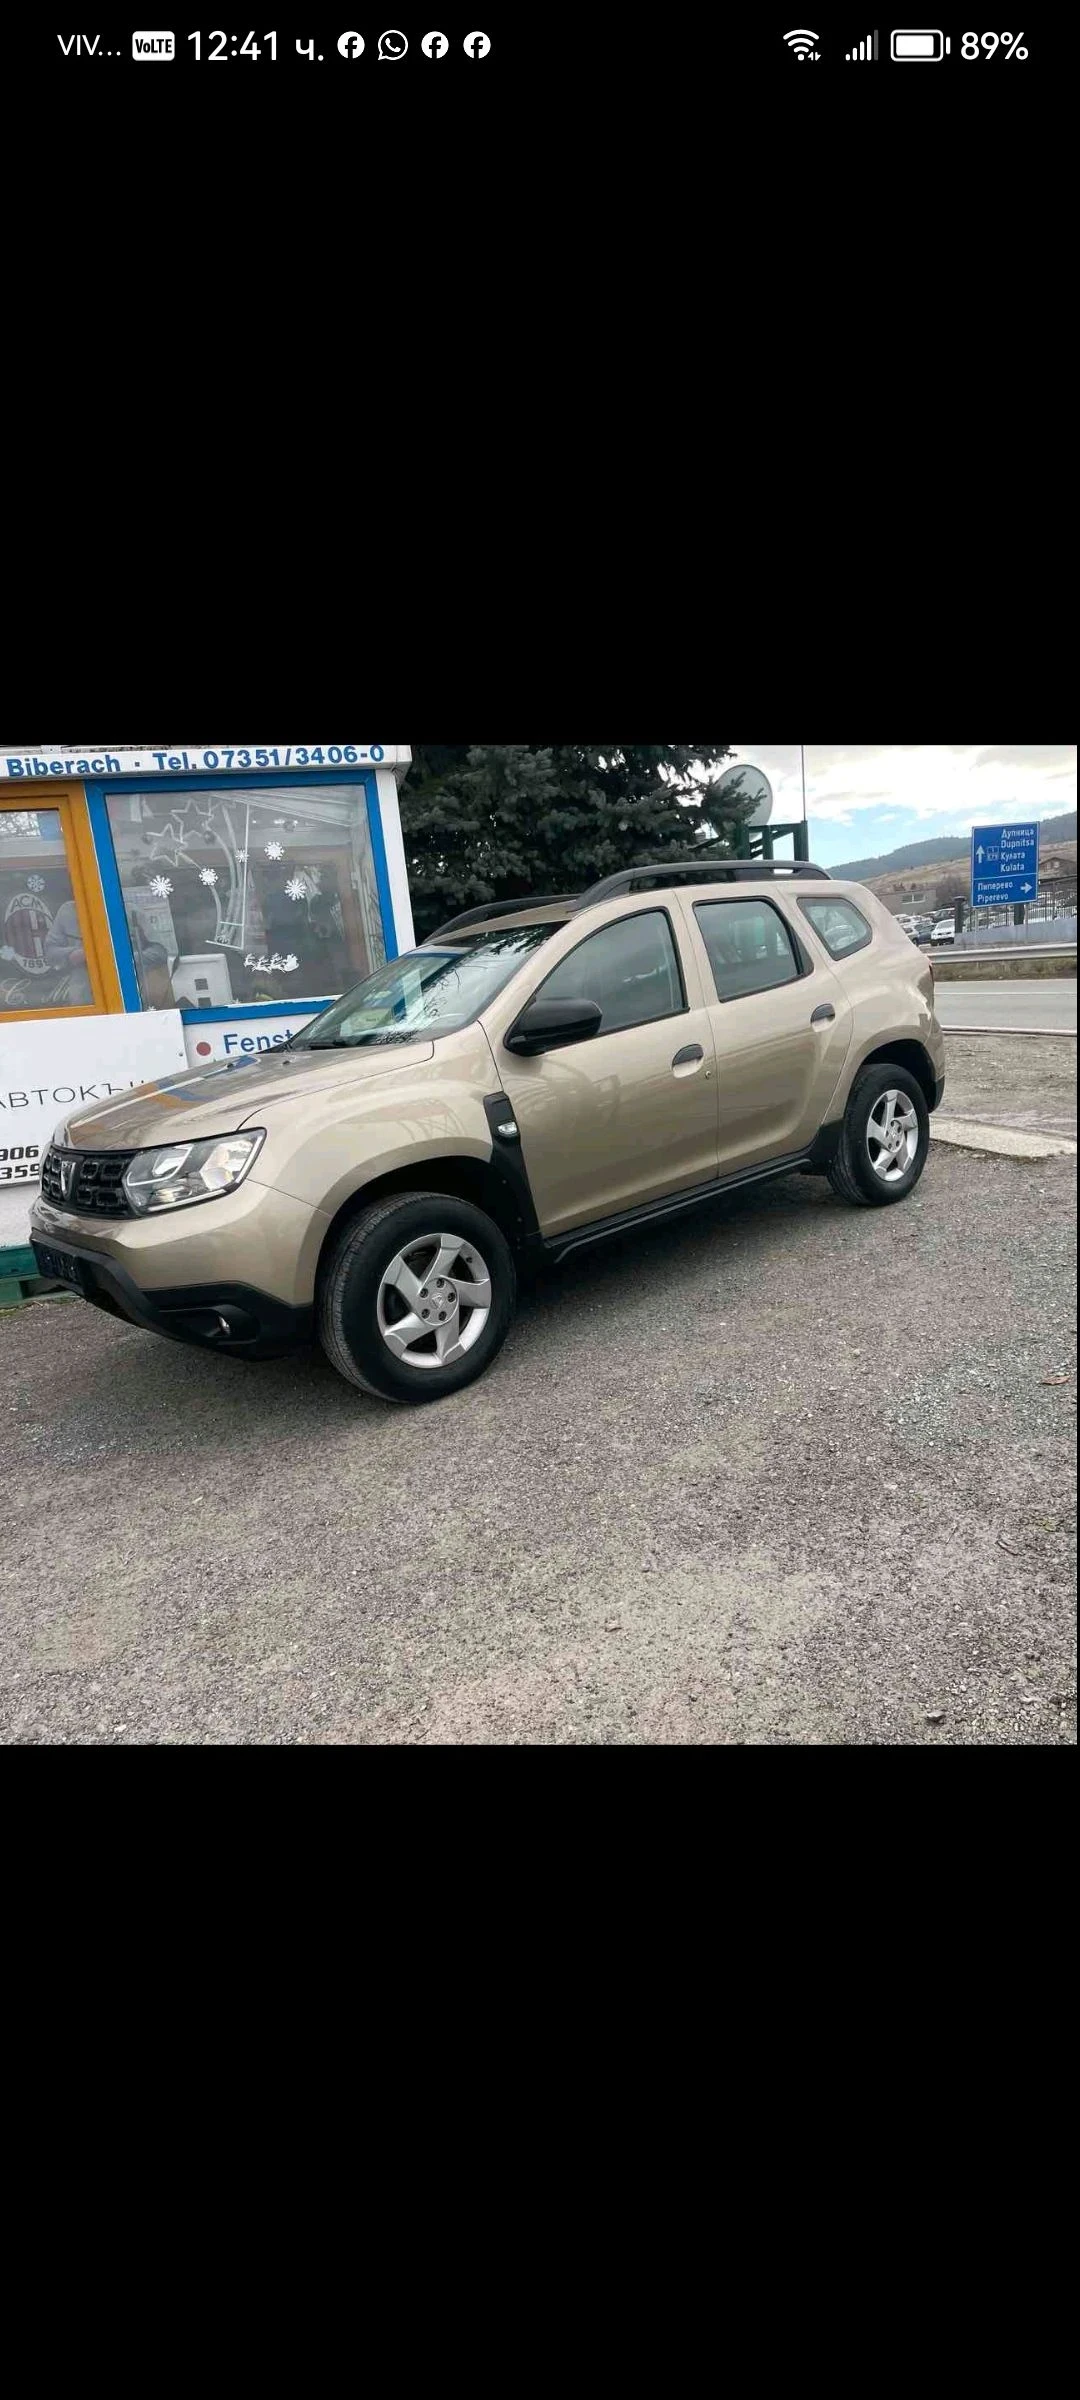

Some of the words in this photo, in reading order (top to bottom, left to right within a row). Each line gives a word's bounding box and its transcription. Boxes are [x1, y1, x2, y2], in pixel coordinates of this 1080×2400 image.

[6, 754, 121, 777] Biberach
[153, 752, 197, 772] Tel.
[203, 745, 385, 770] 07351/3406-0
[1001, 828, 1035, 839] Дупница
[1001, 839, 1035, 849] Dupnitsa
[1000, 852, 1026, 862] Кулата
[1000, 863, 1025, 872] Kulata
[977, 881, 1014, 891] Пиперево
[977, 893, 1009, 904] Piperevo
